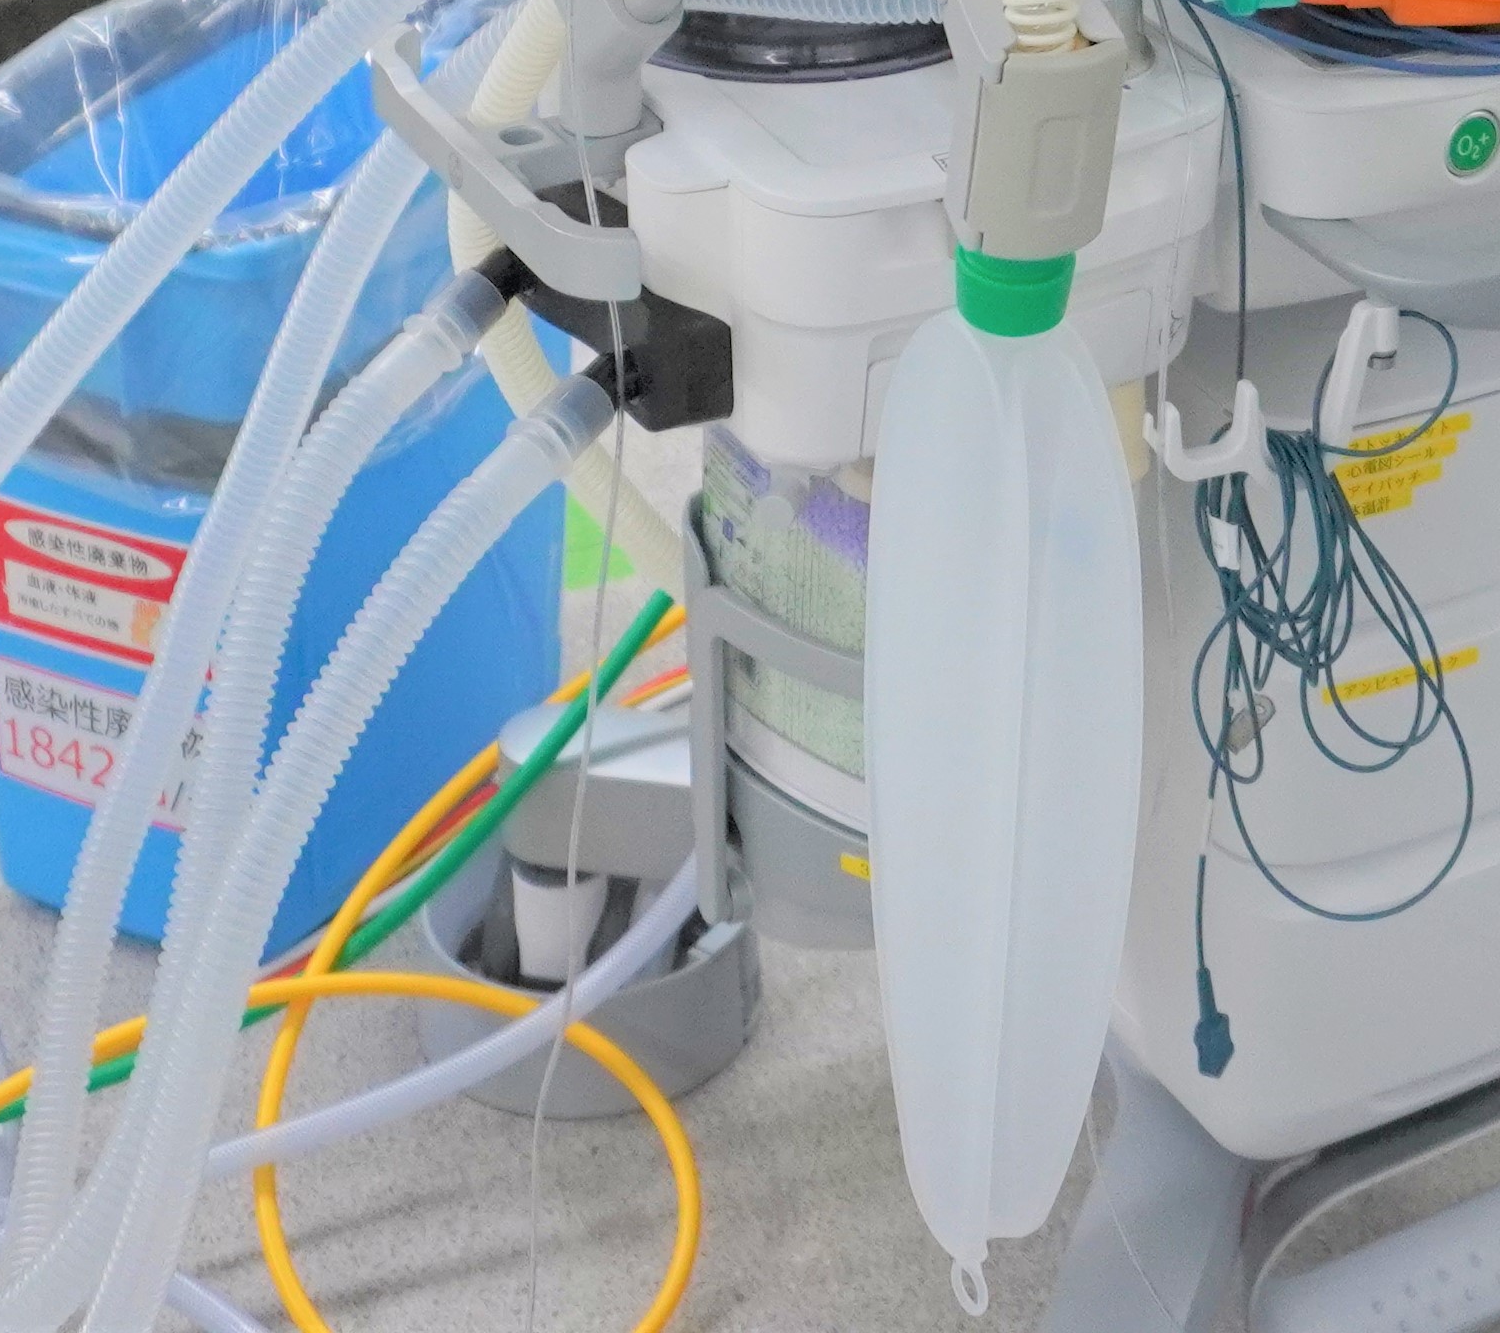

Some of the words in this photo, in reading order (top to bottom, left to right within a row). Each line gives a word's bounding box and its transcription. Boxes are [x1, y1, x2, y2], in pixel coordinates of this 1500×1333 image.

[1347, 446, 1435, 478] 心電図シール
[28, 528, 149, 576] 感染性廃棄物
[5, 717, 114, 788] 1842
